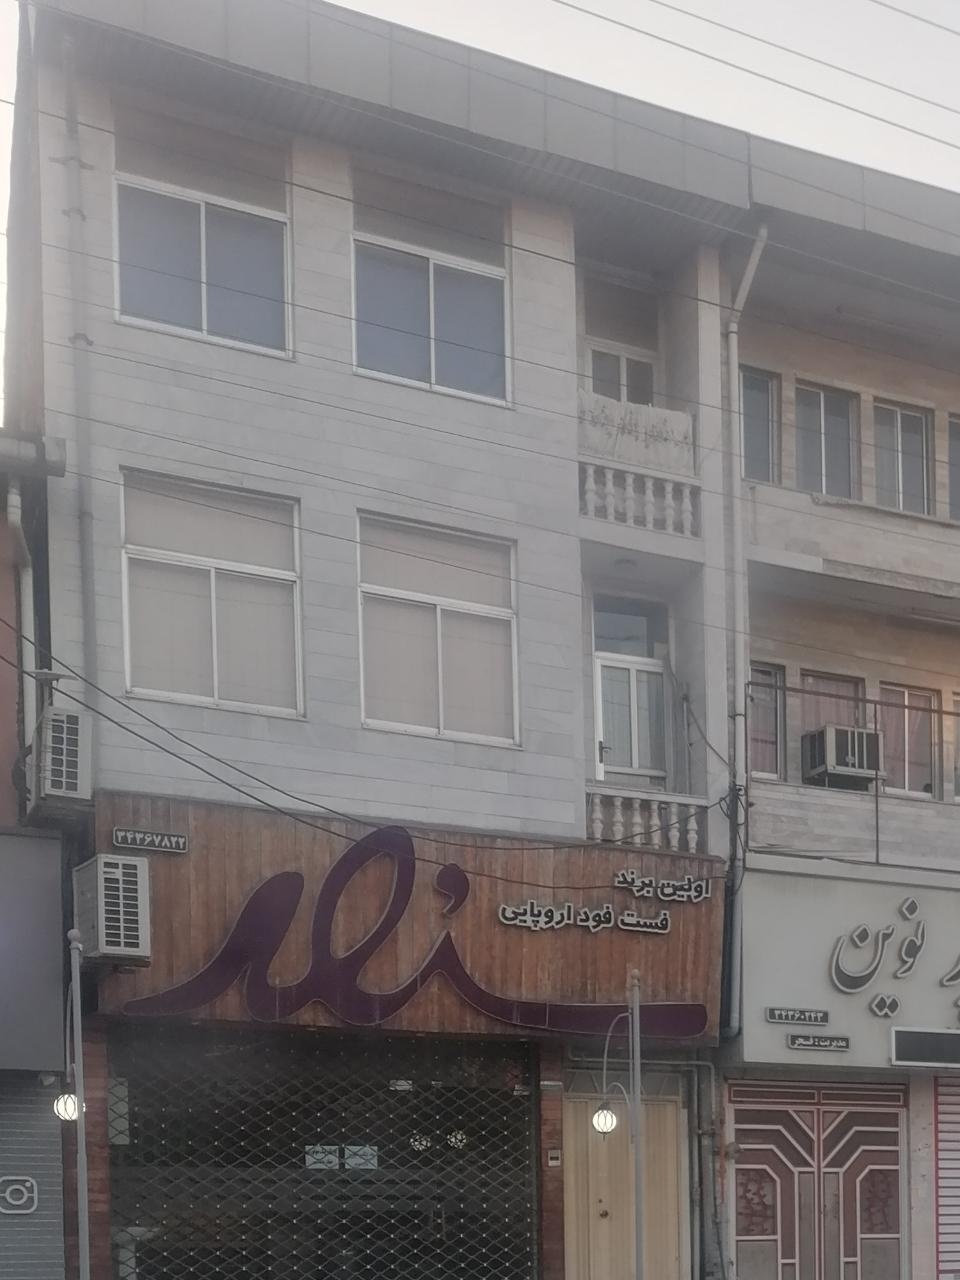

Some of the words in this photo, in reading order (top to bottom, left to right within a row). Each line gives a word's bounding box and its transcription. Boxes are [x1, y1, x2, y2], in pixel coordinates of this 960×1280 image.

[116, 830, 186, 849] ۳۴۳۶۷۸۲۲
[614, 869, 656, 897] برند
[657, 875, 712, 903] اولین
[499, 900, 574, 930] اروپایی
[576, 904, 614, 933] فود
[618, 911, 670, 934] فست
[831, 897, 927, 1017] نوین
